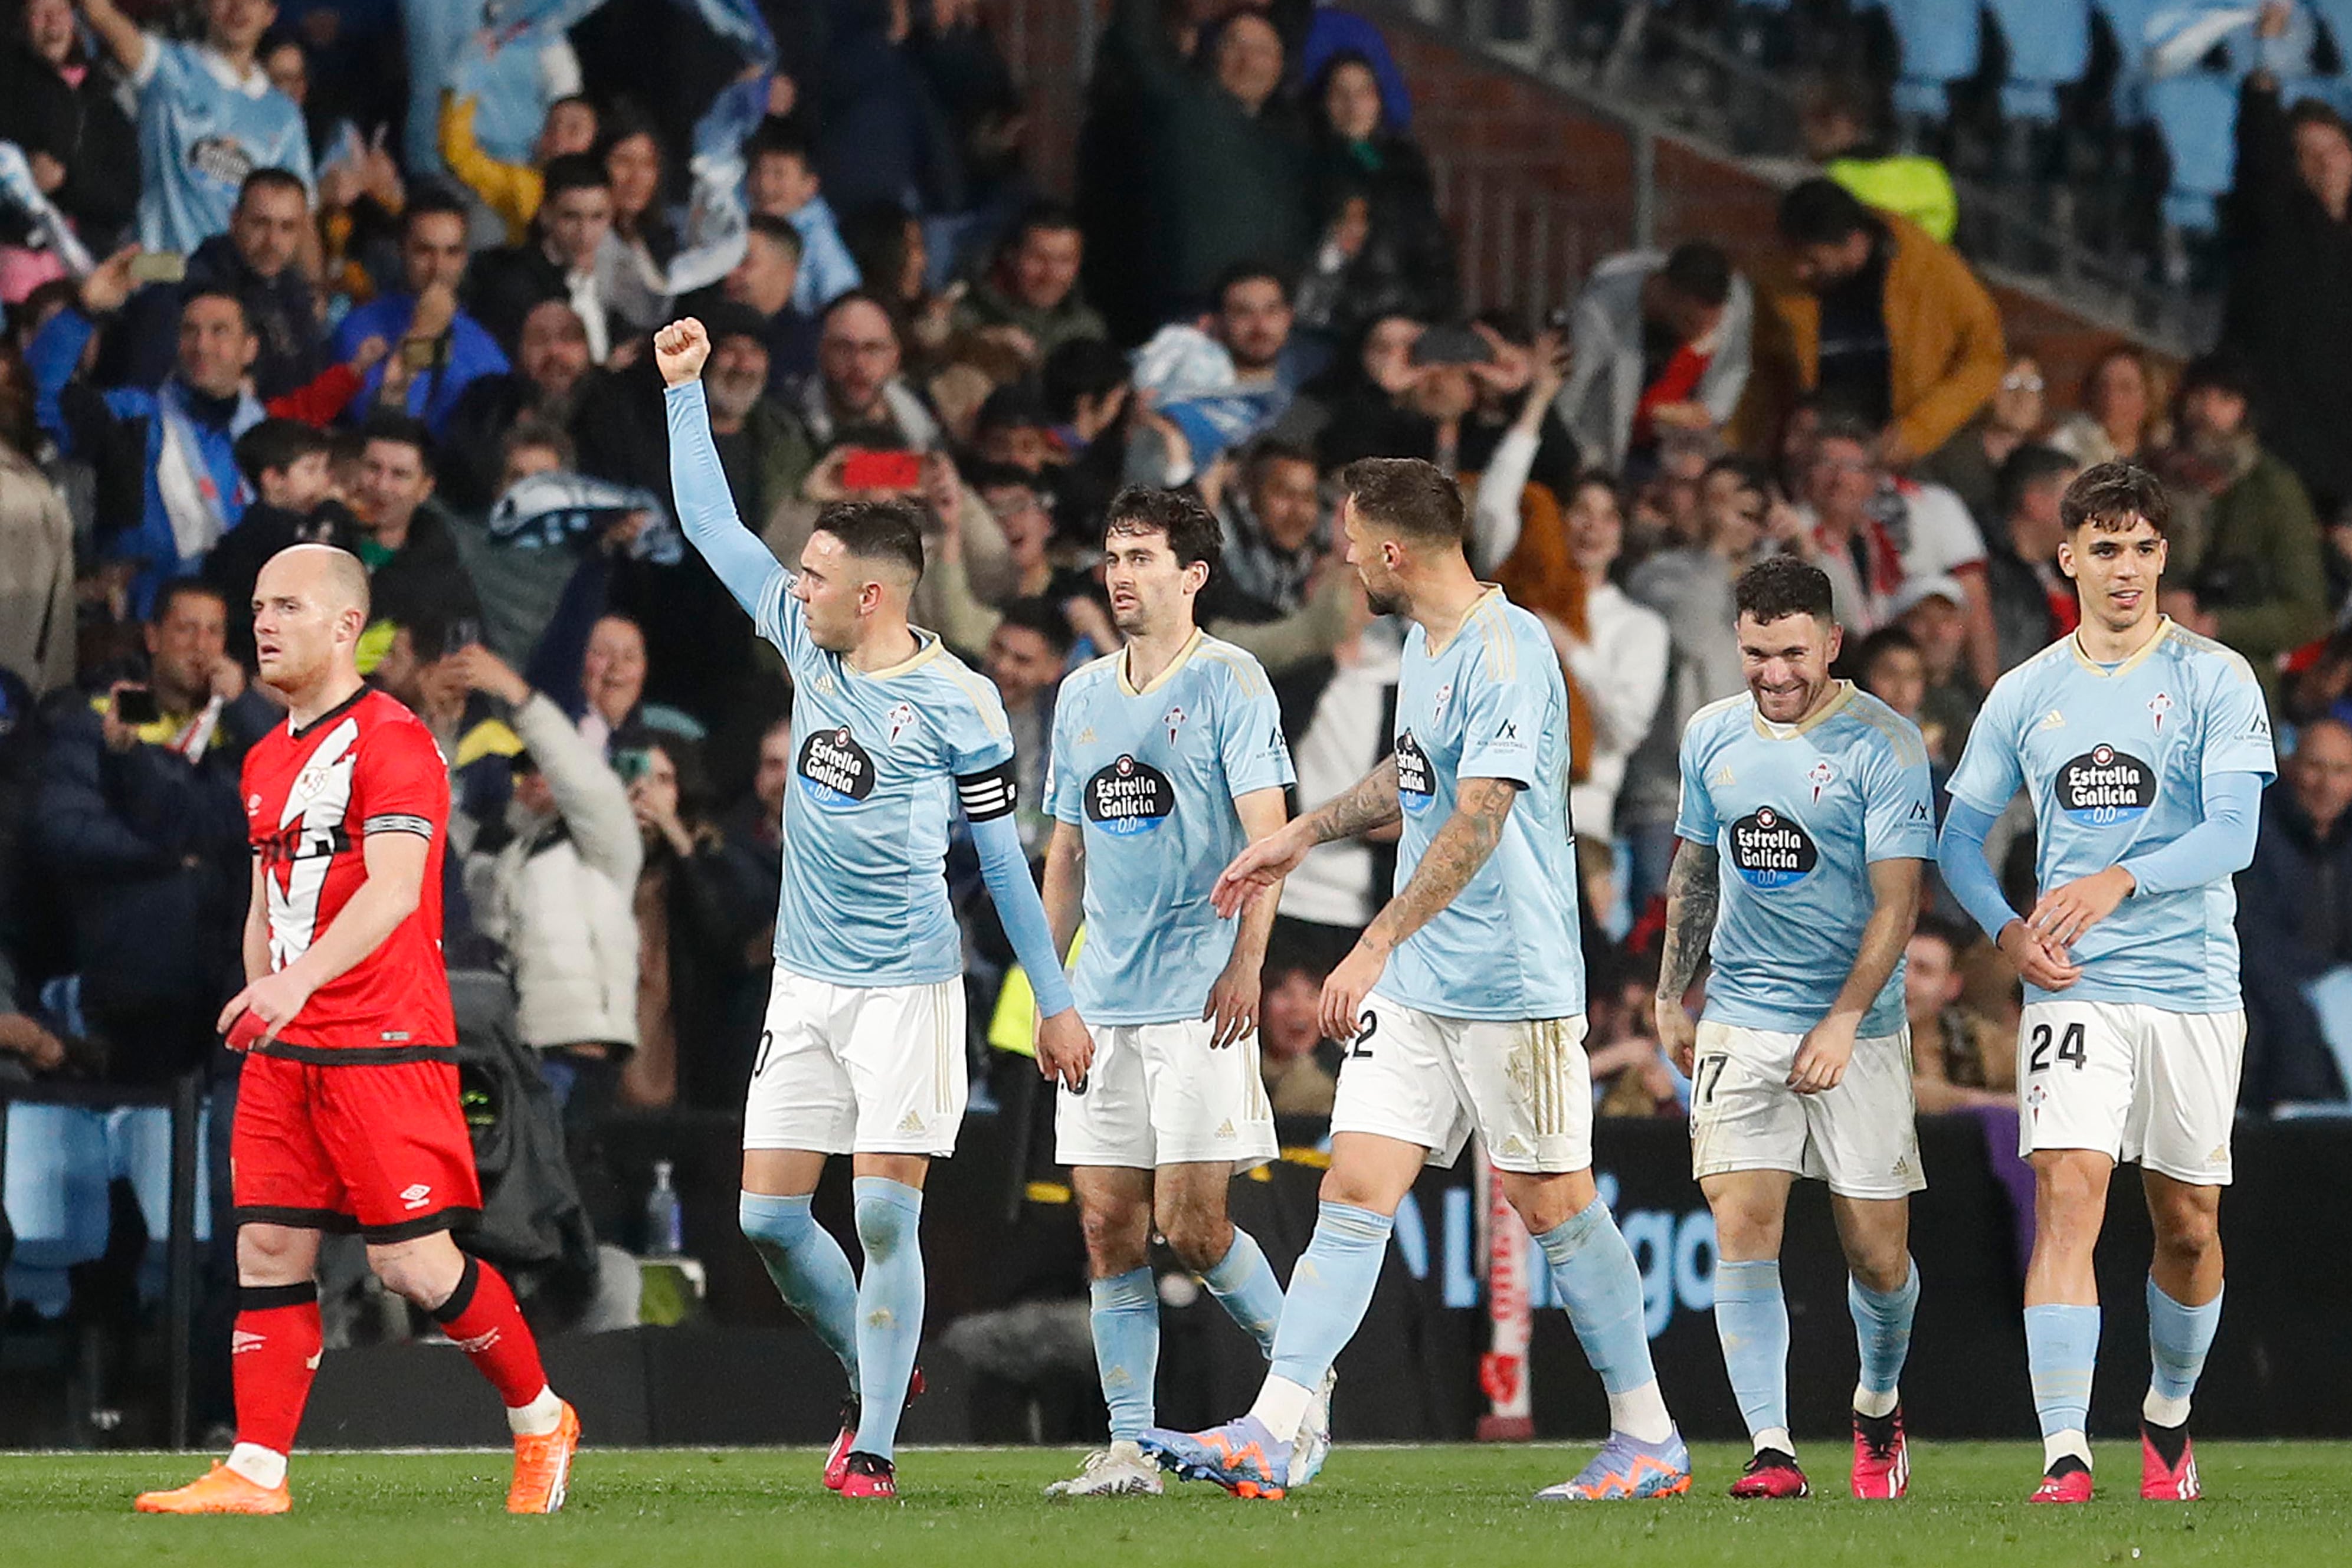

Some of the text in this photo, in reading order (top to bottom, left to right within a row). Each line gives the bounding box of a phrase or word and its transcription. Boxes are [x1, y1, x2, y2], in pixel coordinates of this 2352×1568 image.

[810, 737, 861, 776] Estrella
[806, 755, 853, 793] Galicia
[2069, 766, 2140, 786] Estrella
[1096, 776, 1157, 798] Estrella
[2072, 785, 2137, 806] Galicia
[1099, 796, 1155, 816] Galicia
[1737, 828, 1801, 849] Estrella
[1741, 846, 1798, 868] Galicia
[2030, 1023, 2086, 1071] 24
